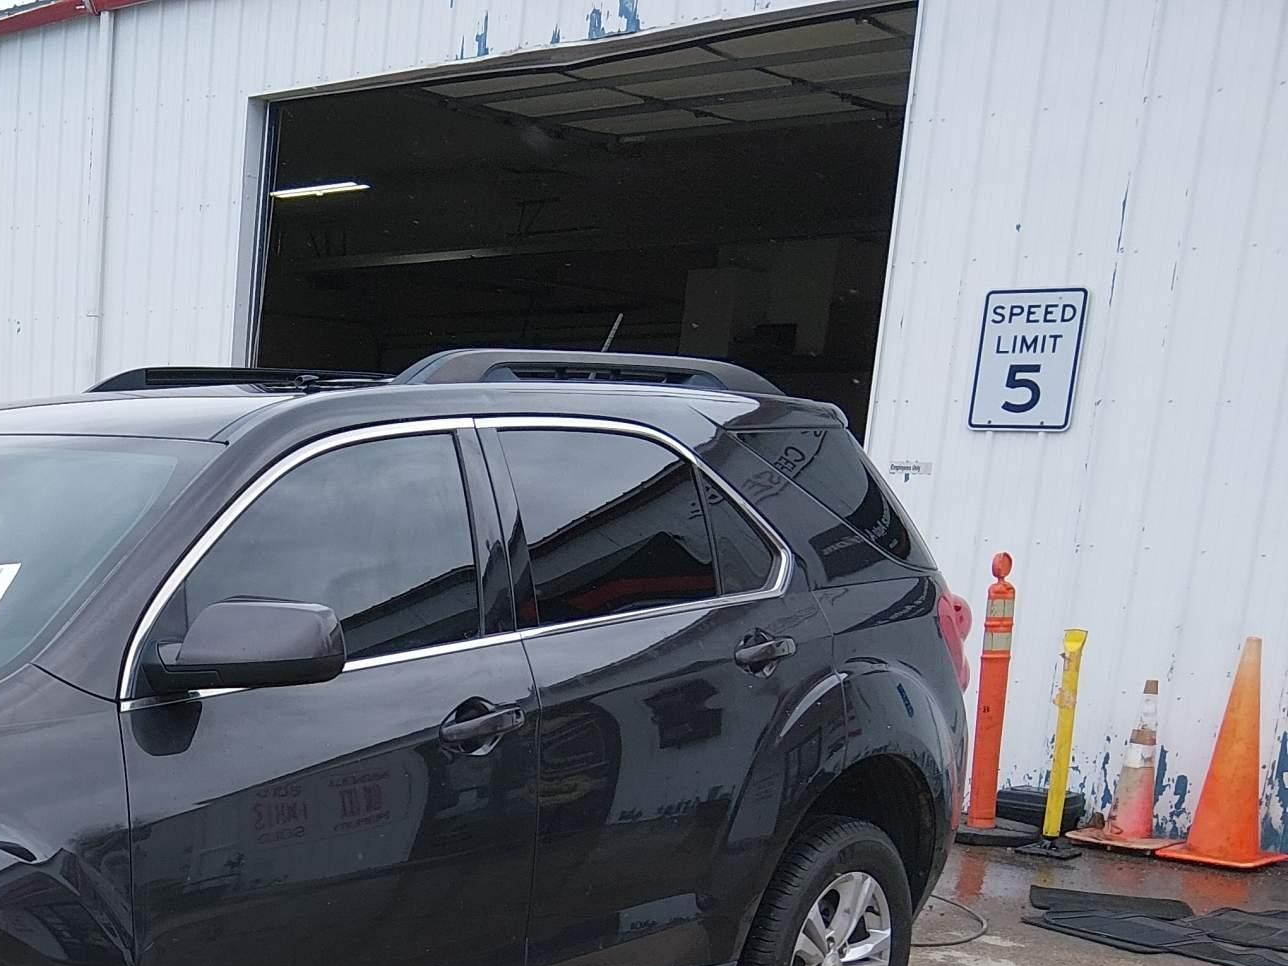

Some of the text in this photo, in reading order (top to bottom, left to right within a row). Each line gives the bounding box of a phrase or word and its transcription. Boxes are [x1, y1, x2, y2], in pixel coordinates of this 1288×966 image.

[991, 303, 1077, 324] SPEED
[995, 334, 1064, 354] LIMIT
[1001, 364, 1041, 414] 5
